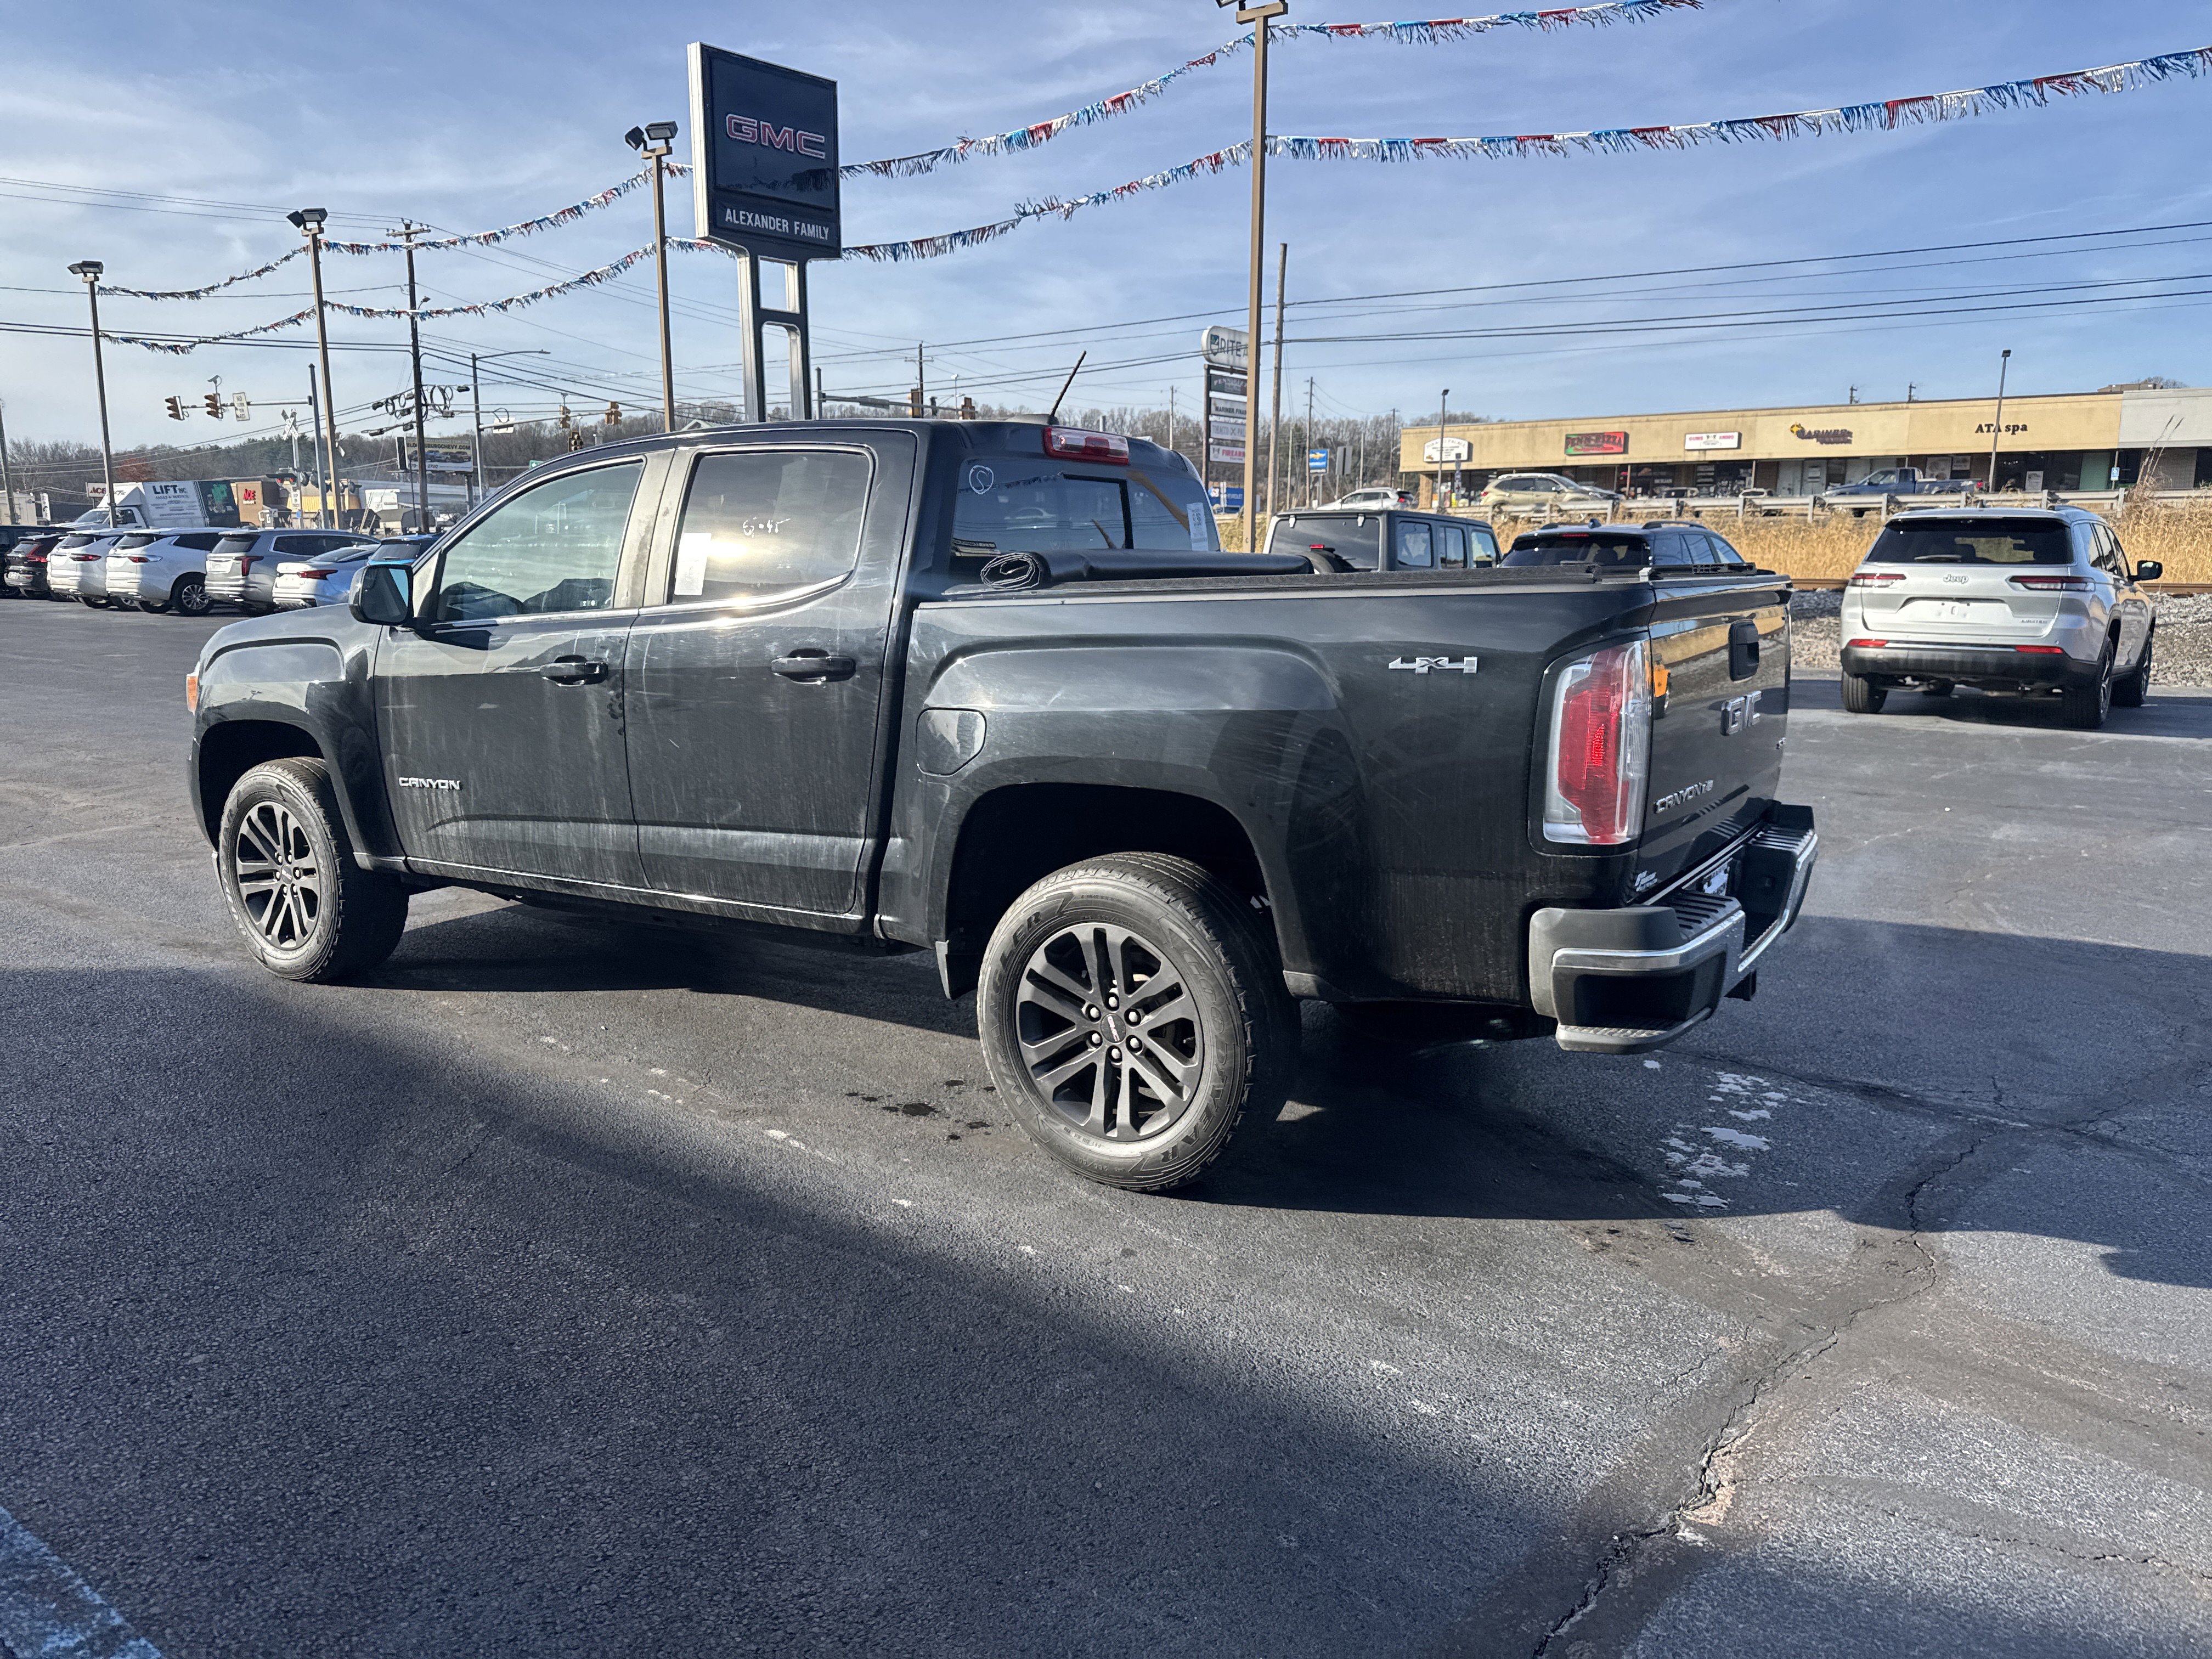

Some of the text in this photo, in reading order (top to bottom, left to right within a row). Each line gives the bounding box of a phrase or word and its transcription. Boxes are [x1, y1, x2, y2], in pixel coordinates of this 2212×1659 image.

[726, 113, 825, 160] GMC
[725, 208, 830, 241] ALEXANDER FAMILY
[1220, 337, 1242, 357] RITE
[1974, 424, 2028, 436] ATA spa
[153, 484, 178, 494] LIFT
[243, 488, 256, 500] ACE
[1943, 574, 1969, 584] Jeep
[398, 776, 462, 791] CANYON
[1654, 782, 1706, 814] CANYON
[1161, 951, 1228, 1164] GOODYEAR
